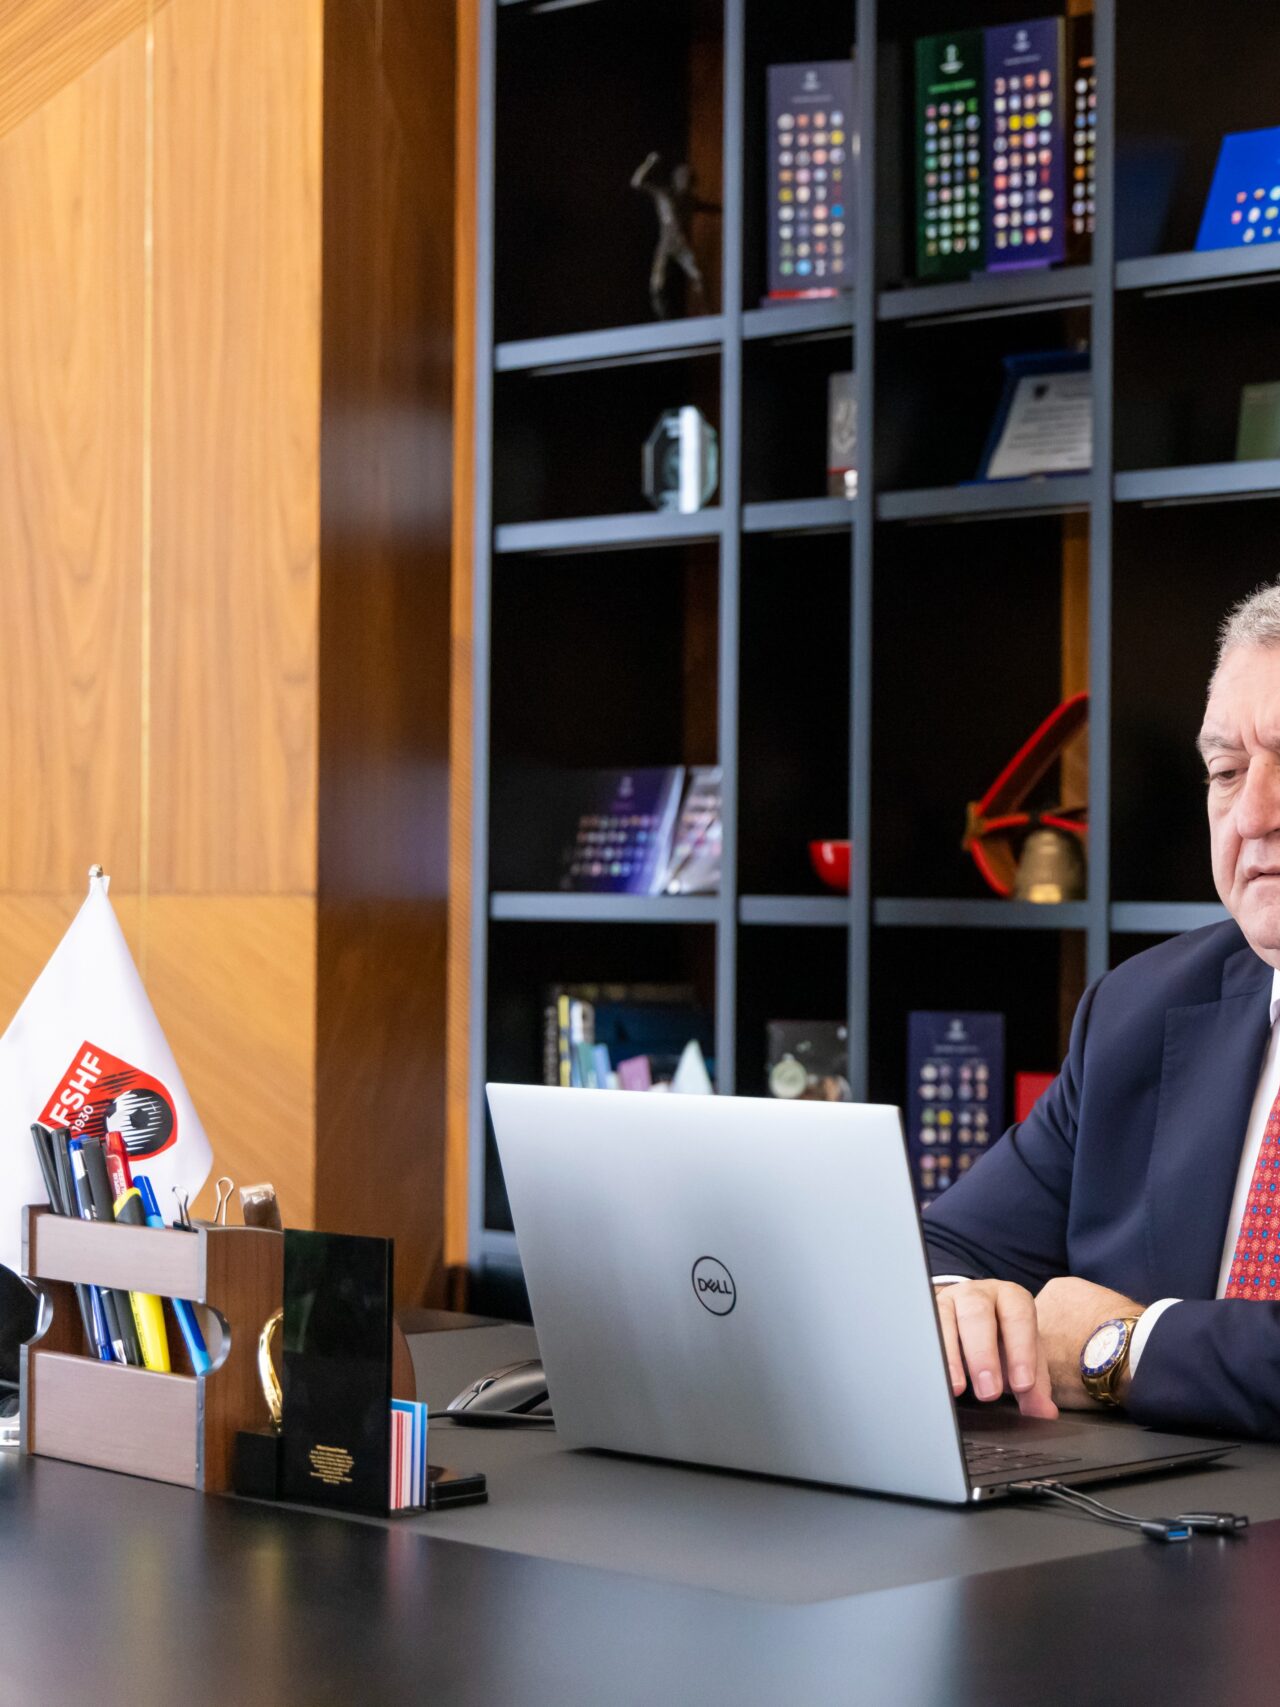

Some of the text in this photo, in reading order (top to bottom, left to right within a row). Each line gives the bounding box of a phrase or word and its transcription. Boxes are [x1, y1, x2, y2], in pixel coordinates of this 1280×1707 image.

[49, 1051, 102, 1127] FSHF
[72, 1104, 94, 1132] 1930
[697, 1277, 732, 1295] DELL
